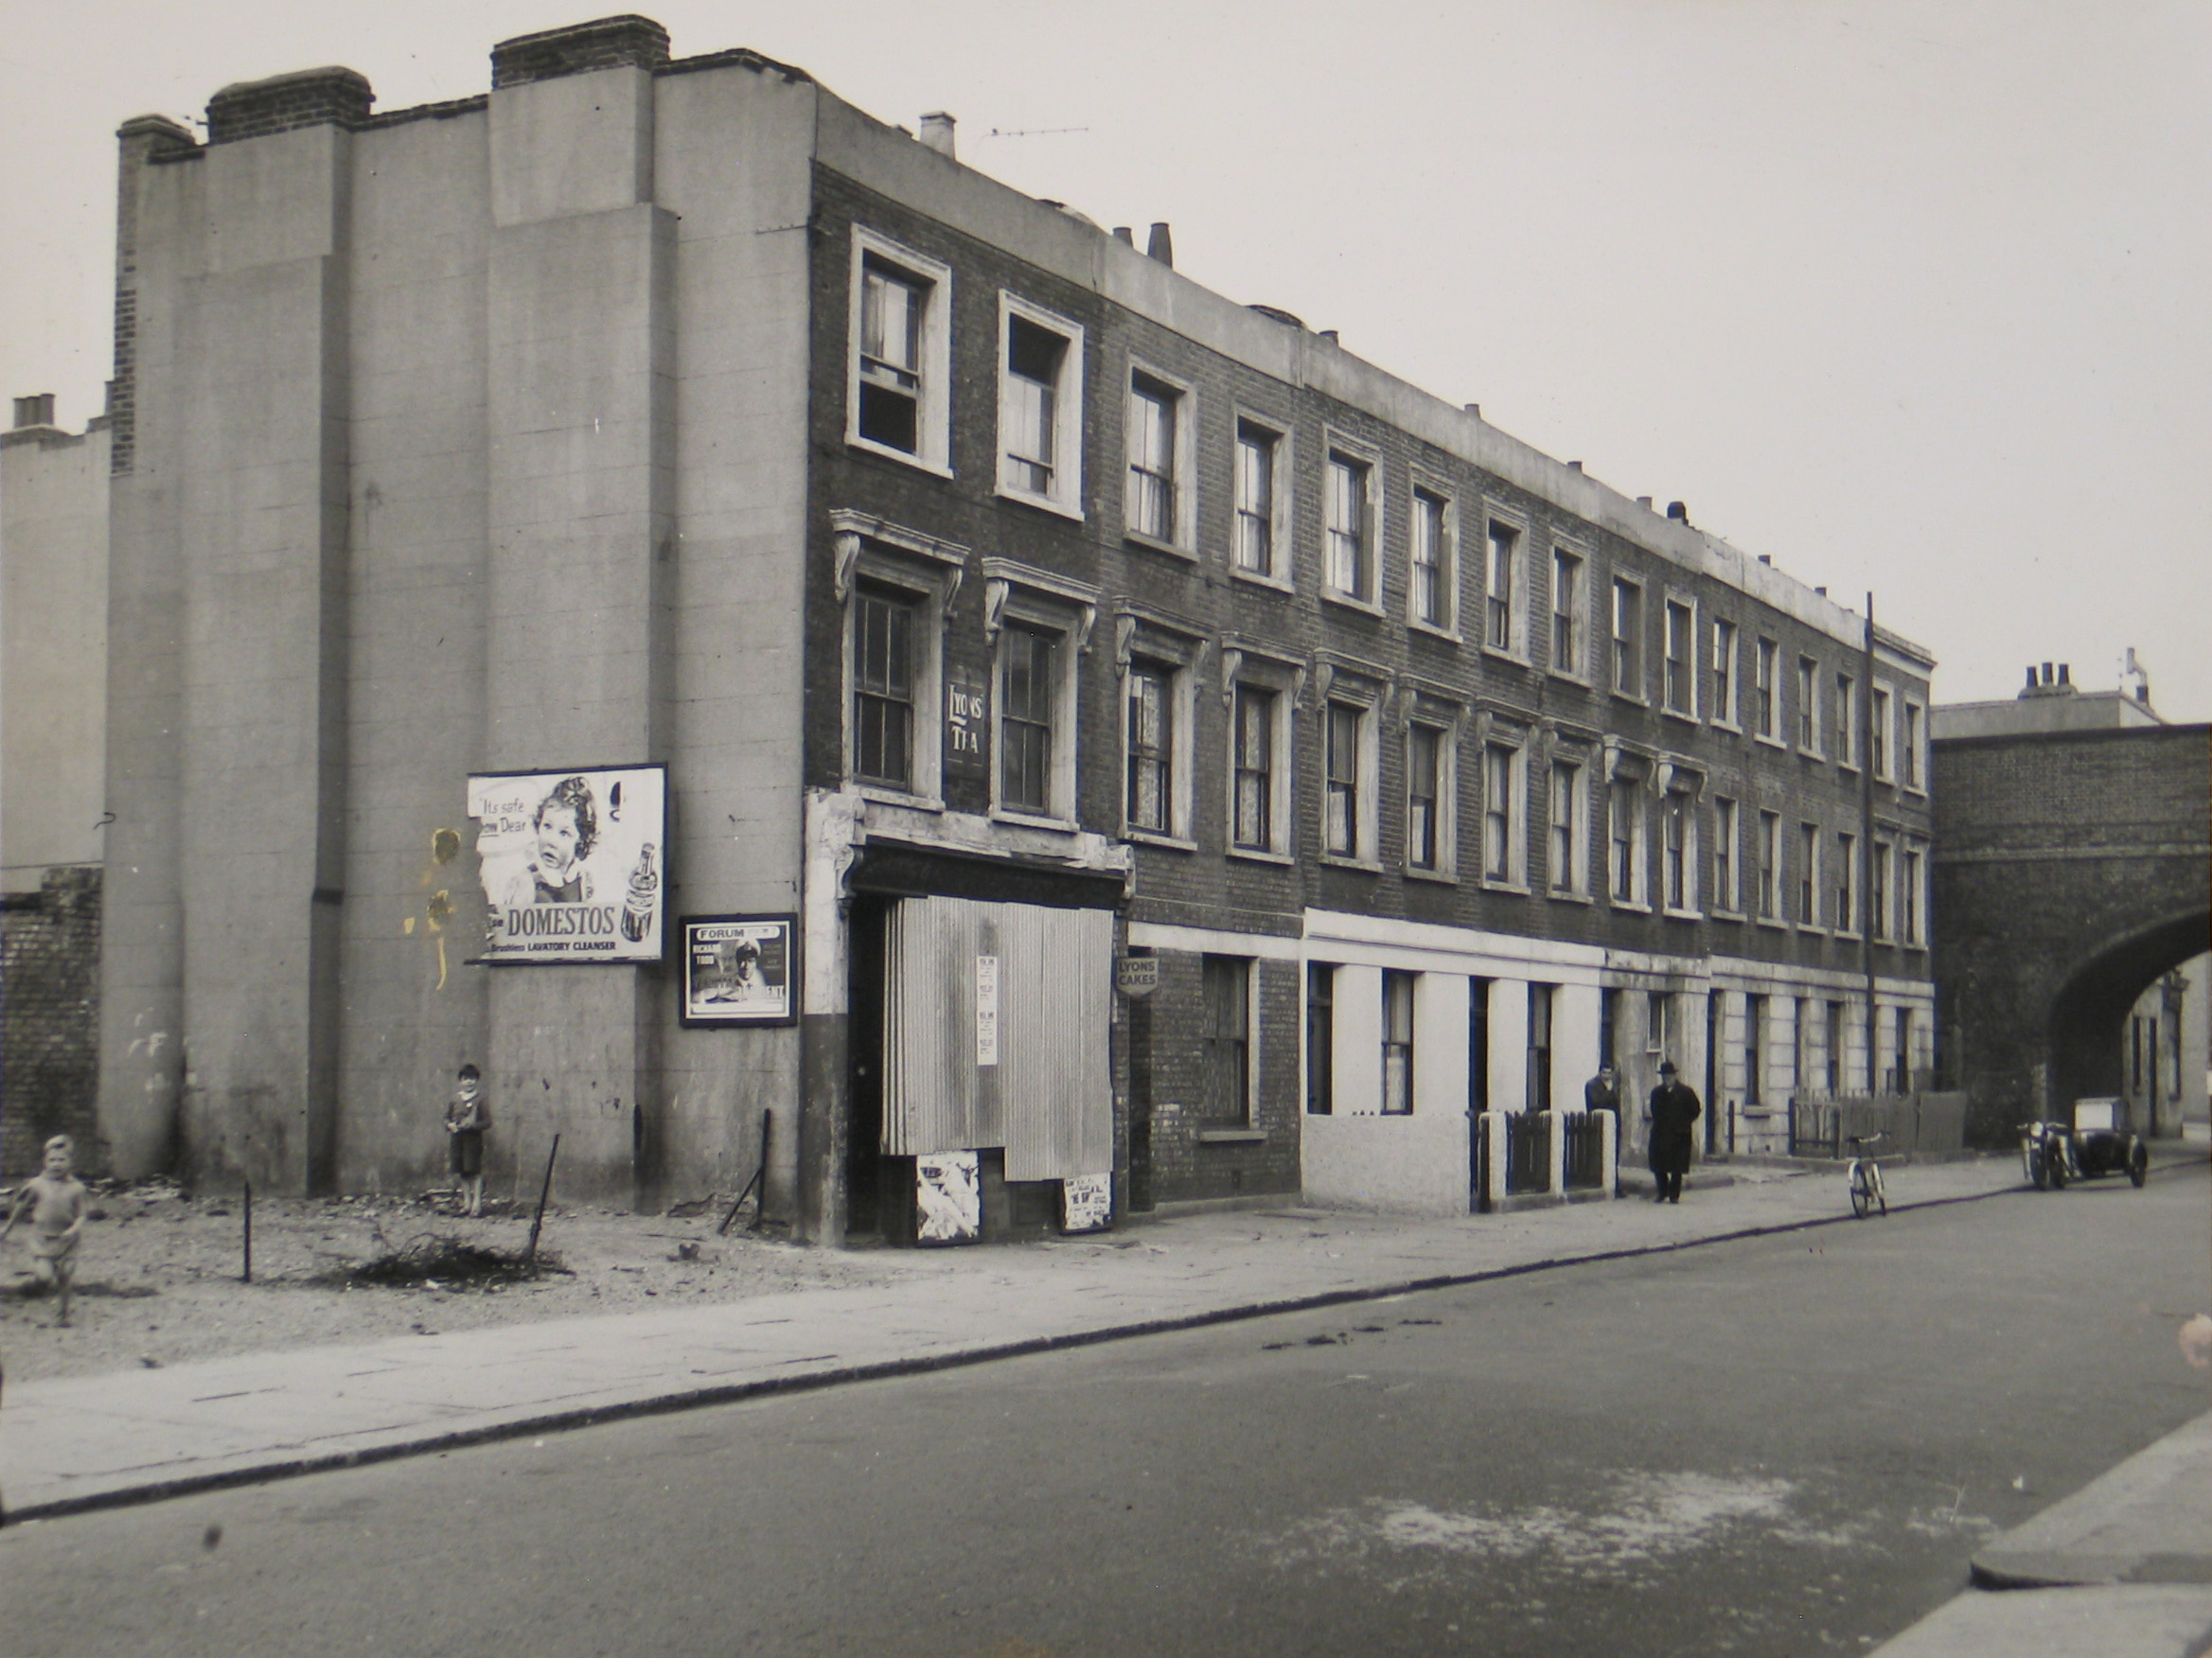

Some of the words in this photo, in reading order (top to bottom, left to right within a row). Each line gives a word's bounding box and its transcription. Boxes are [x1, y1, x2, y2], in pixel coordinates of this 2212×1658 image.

[507, 907, 615, 936] DOMESTOS
[700, 928, 745, 939] FORUM
[527, 943, 571, 952] LAVATORY
[573, 942, 616, 950] CLEANSER
[1119, 961, 1155, 973] LYONS
[1119, 975, 1156, 986] CAKES
